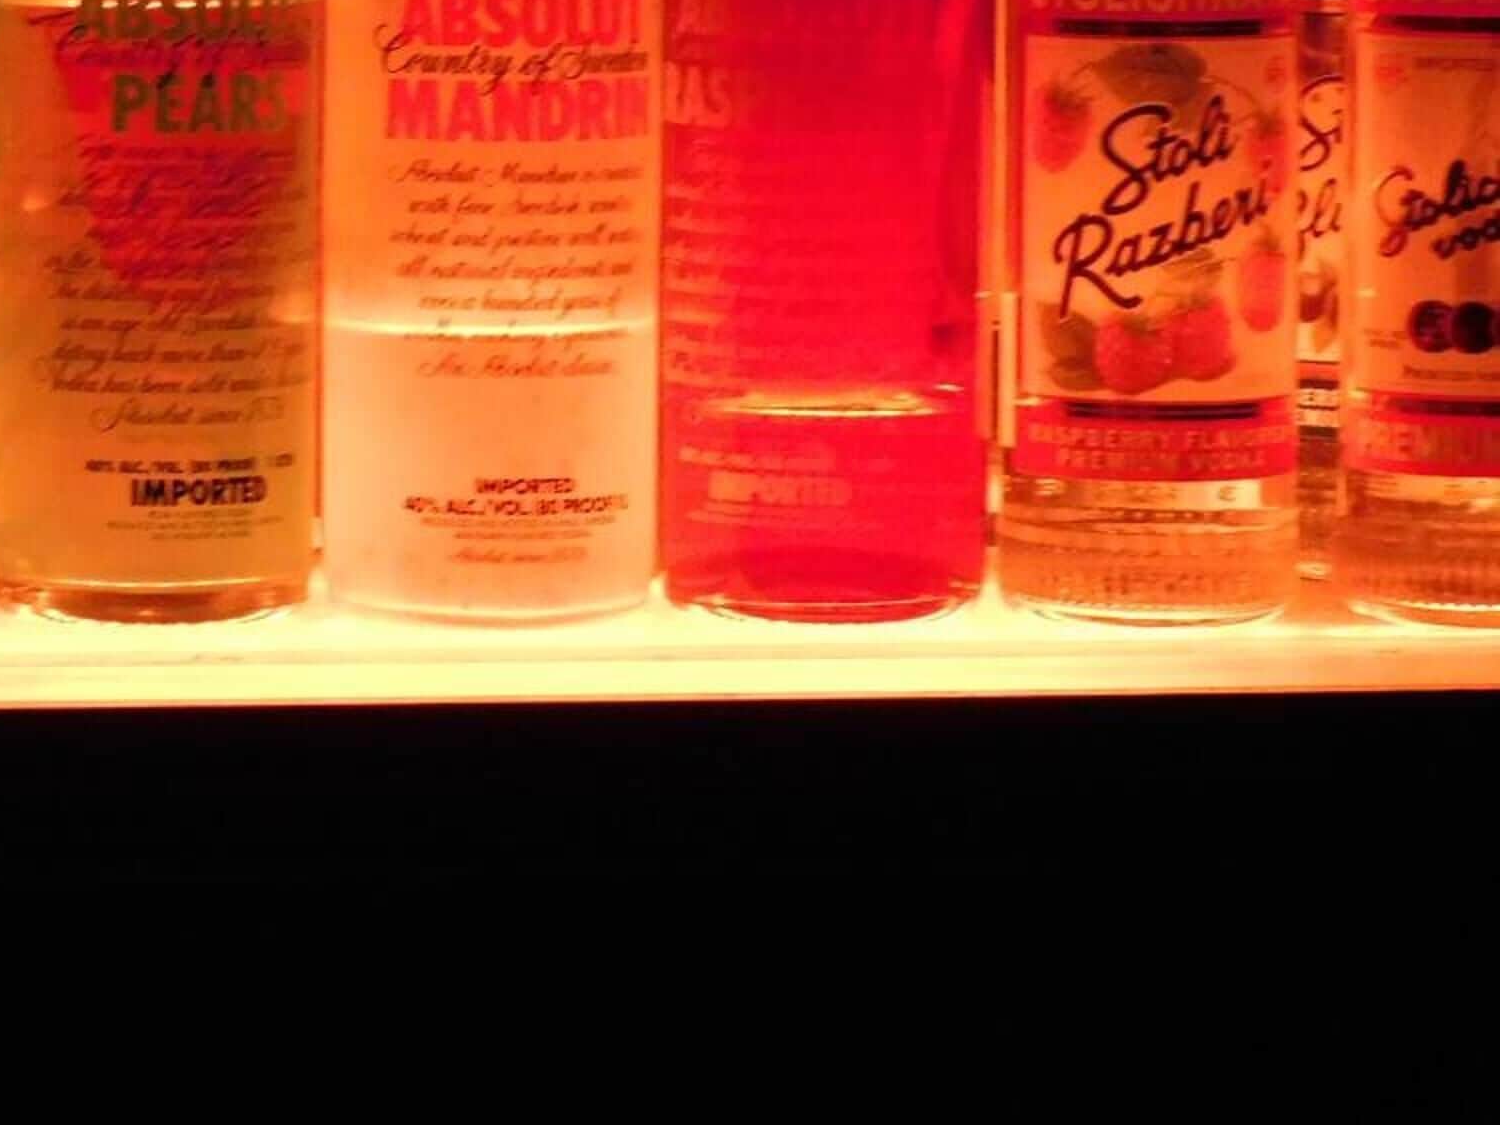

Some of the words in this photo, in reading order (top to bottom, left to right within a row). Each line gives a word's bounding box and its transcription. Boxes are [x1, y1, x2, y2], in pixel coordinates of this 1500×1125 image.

[373, 22, 512, 97] Country
[518, 42, 562, 96] of
[110, 72, 288, 134] PEARS
[386, 78, 650, 142] MANDRIN
[1101, 94, 1235, 216] Stoli
[1053, 178, 1272, 319] Razberi
[130, 475, 268, 507] IMPORTED
[472, 477, 577, 495] IMPORTED
